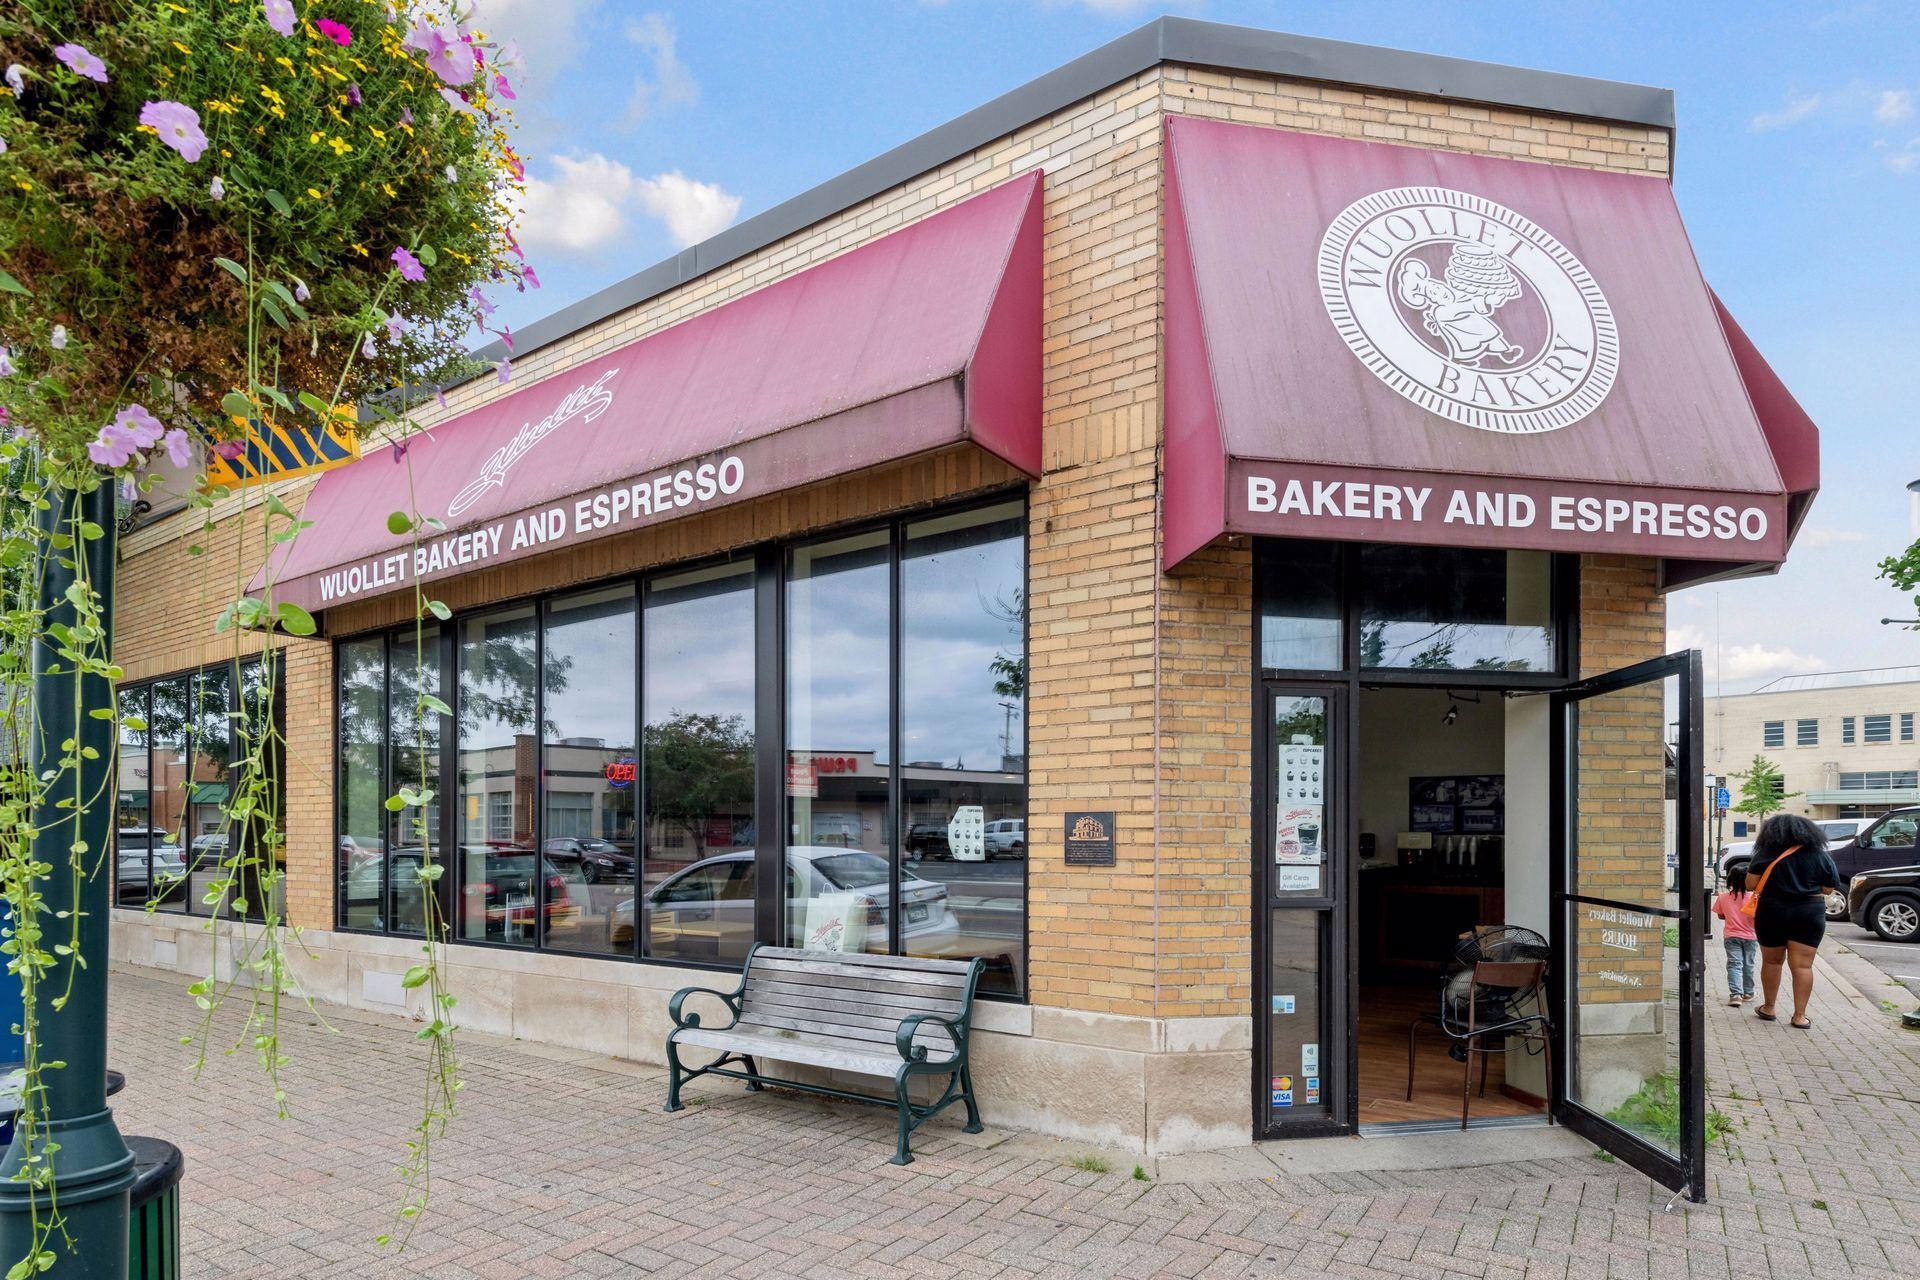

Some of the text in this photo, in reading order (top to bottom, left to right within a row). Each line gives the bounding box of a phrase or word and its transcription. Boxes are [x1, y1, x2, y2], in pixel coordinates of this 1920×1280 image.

[1348, 209, 1534, 289] WUOLLET
[1434, 333, 1588, 407] BAKERY
[320, 456, 745, 601] WUOLLET BAKERY AND ESPRESSO
[1247, 476, 1768, 541] BAKERY AND ESPRESSO
